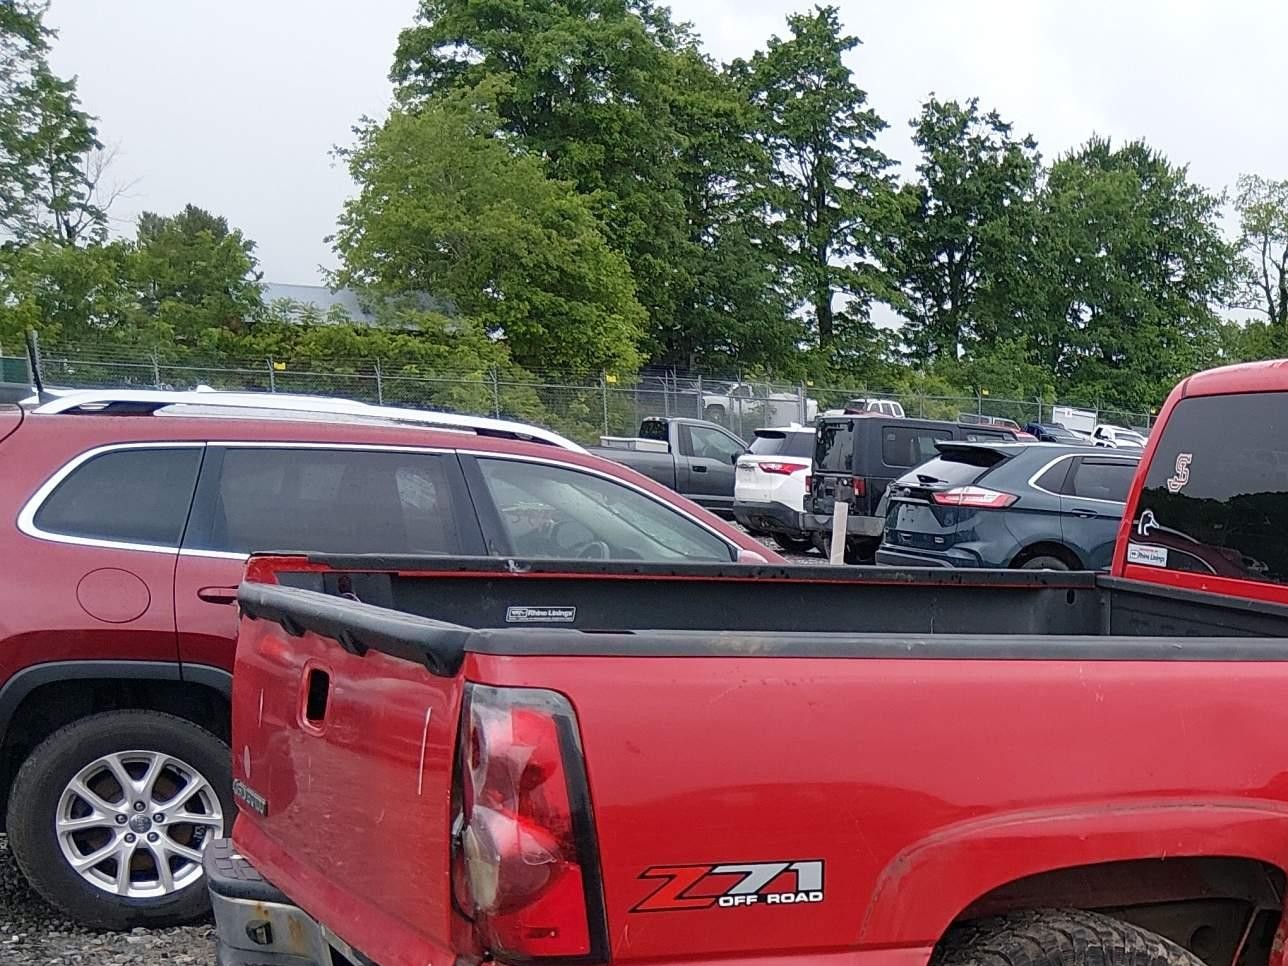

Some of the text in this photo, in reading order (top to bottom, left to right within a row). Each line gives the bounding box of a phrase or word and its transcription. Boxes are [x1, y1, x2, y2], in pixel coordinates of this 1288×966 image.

[528, 609, 548, 617] Rhino
[628, 859, 826, 914] Z71
[718, 892, 824, 908] OFF ROAD
